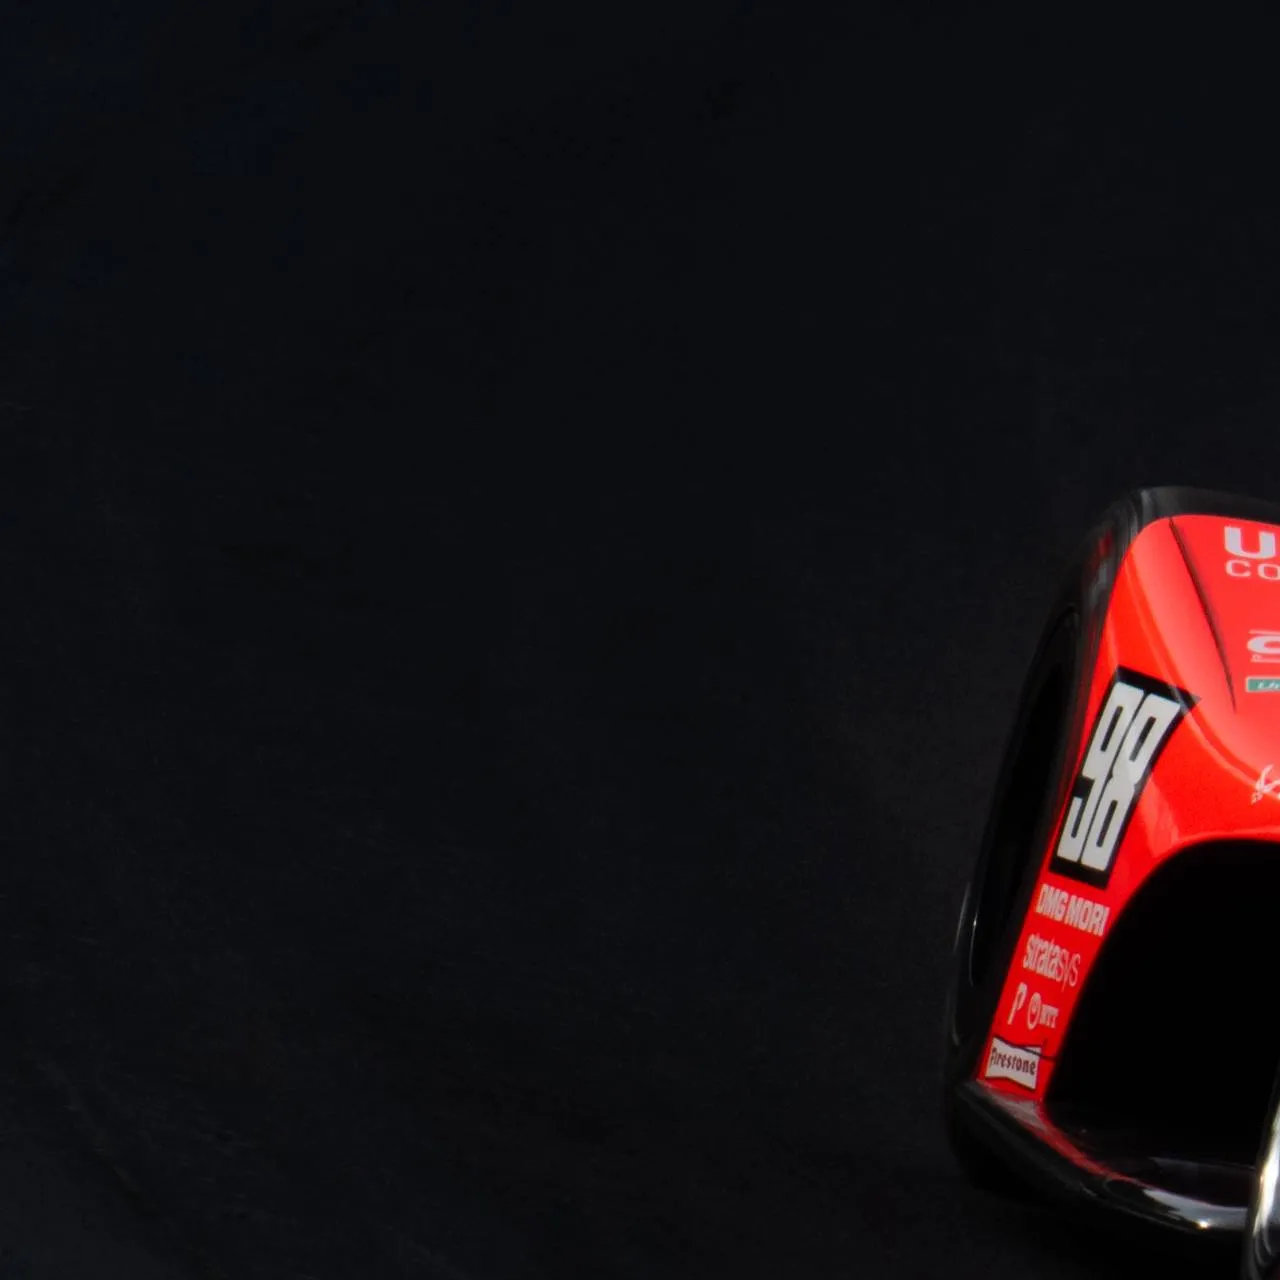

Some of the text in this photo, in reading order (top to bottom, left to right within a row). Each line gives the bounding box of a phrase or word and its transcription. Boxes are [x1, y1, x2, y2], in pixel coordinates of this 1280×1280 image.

[1057, 681, 1181, 872] 98
[1036, 884, 1110, 937] DMG MORI
[1023, 933, 1081, 992] stratasys
[990, 1048, 1036, 1076] Firestone
